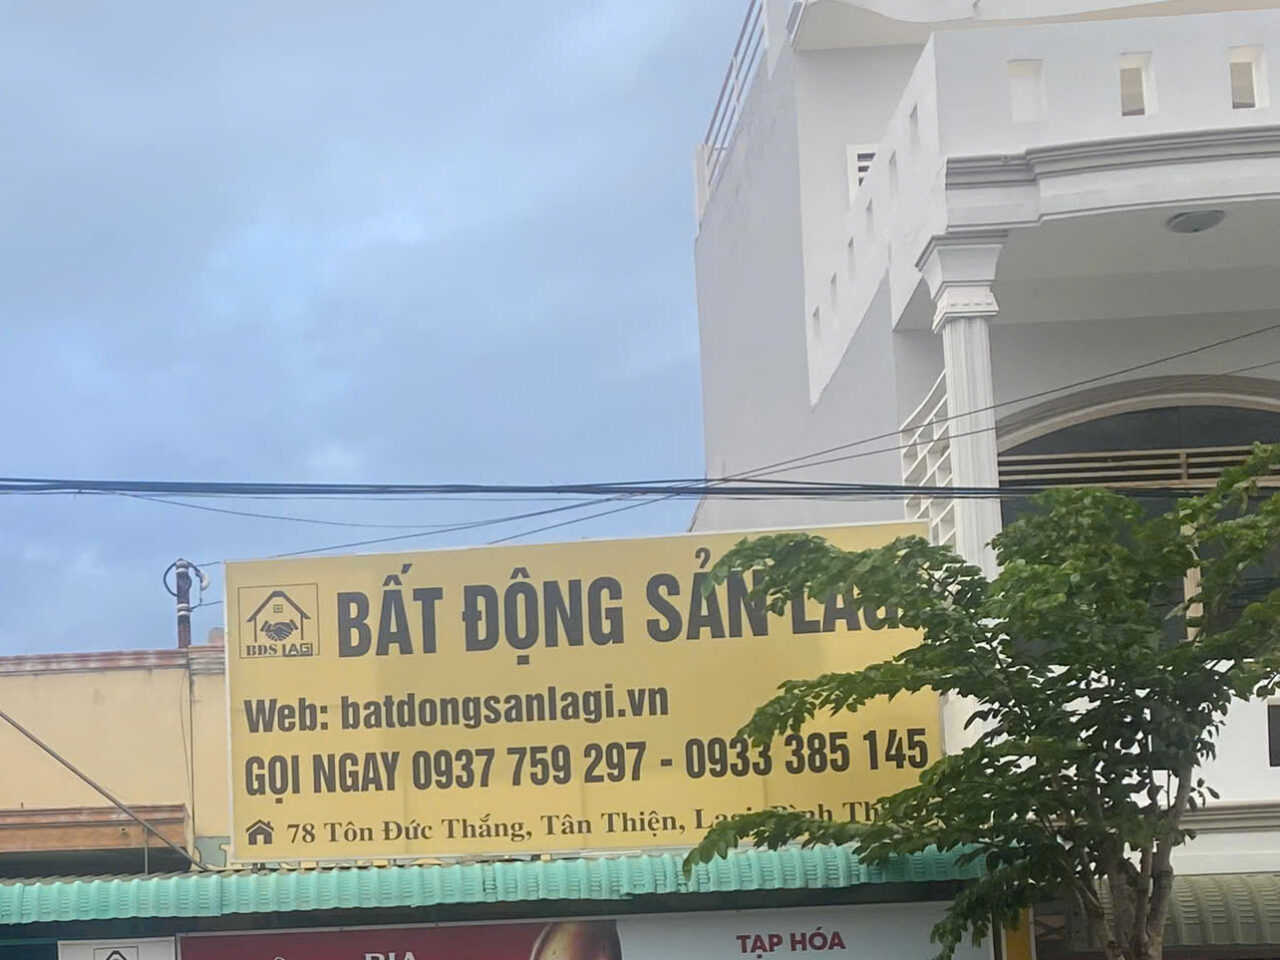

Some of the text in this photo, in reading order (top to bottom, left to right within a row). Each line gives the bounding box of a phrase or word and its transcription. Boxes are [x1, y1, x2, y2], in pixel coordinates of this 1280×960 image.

[337, 547, 768, 665] BẤT ĐỘNG SẢN
[246, 645, 277, 656] BDS
[244, 683, 668, 733] Web: batdongsanlagi.vn
[245, 728, 928, 804] GỌI NGAY 0937 759 297 0933 385 145
[287, 809, 685, 844] 78 Tôn Đức Thắng, Tân Thiện,
[736, 927, 846, 958] TẠP HÓA
